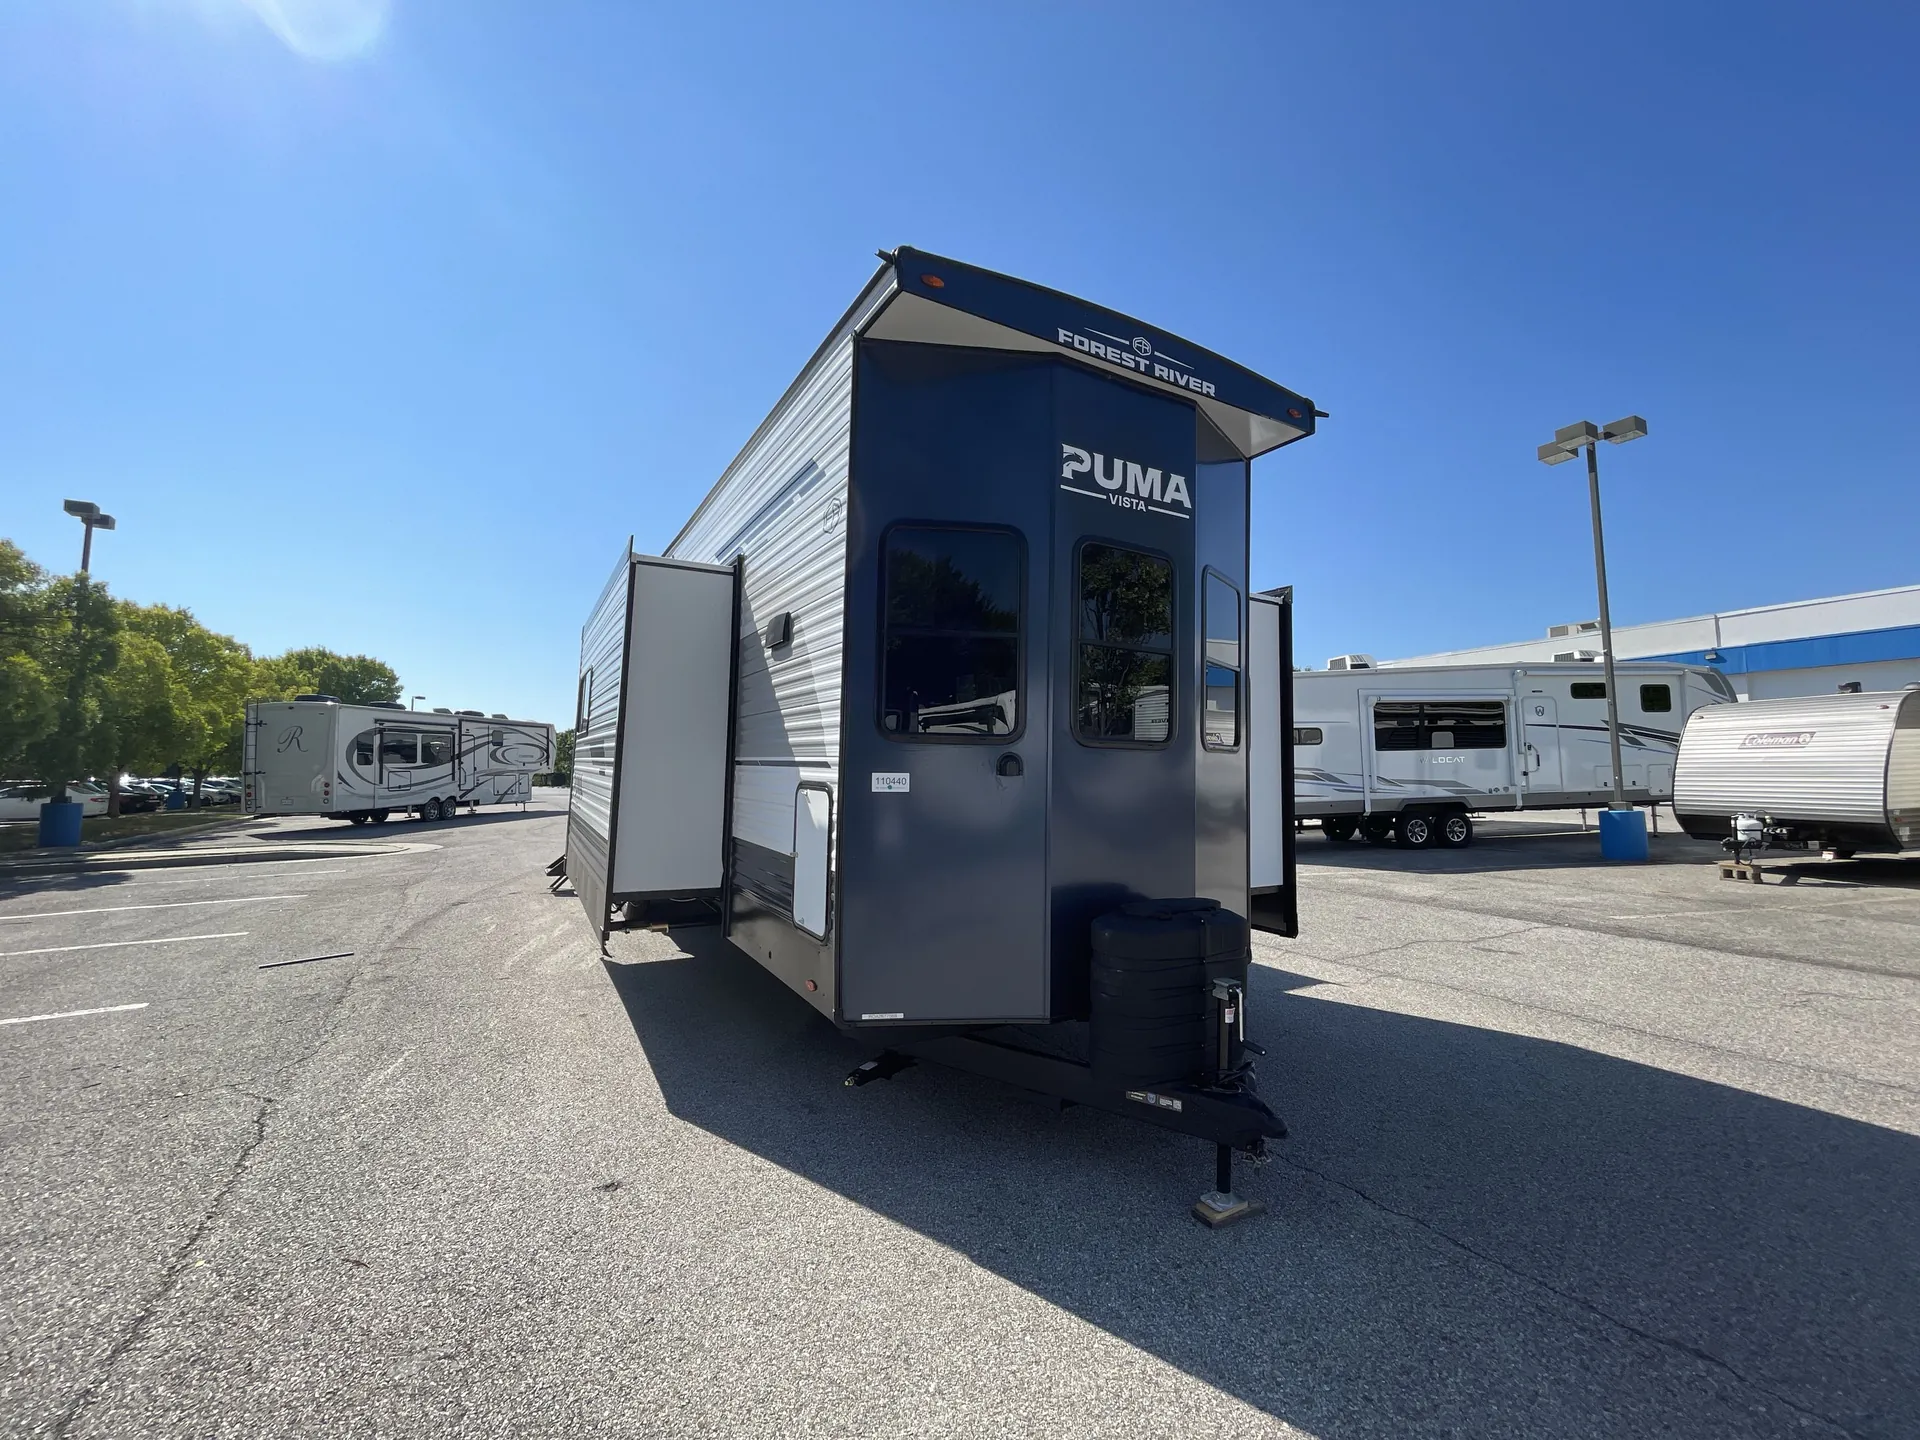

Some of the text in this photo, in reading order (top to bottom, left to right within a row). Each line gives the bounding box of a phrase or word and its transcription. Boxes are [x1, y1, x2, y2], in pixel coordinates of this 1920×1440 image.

[1057, 328, 1216, 397] FOREST RIVER
[1061, 443, 1192, 509] PUMA
[1108, 493, 1147, 512] VISTA
[277, 725, 309, 753] R
[1745, 733, 1799, 746] Coleman
[1419, 756, 1466, 764] WLDCAT
[875, 777, 907, 786] 110440
